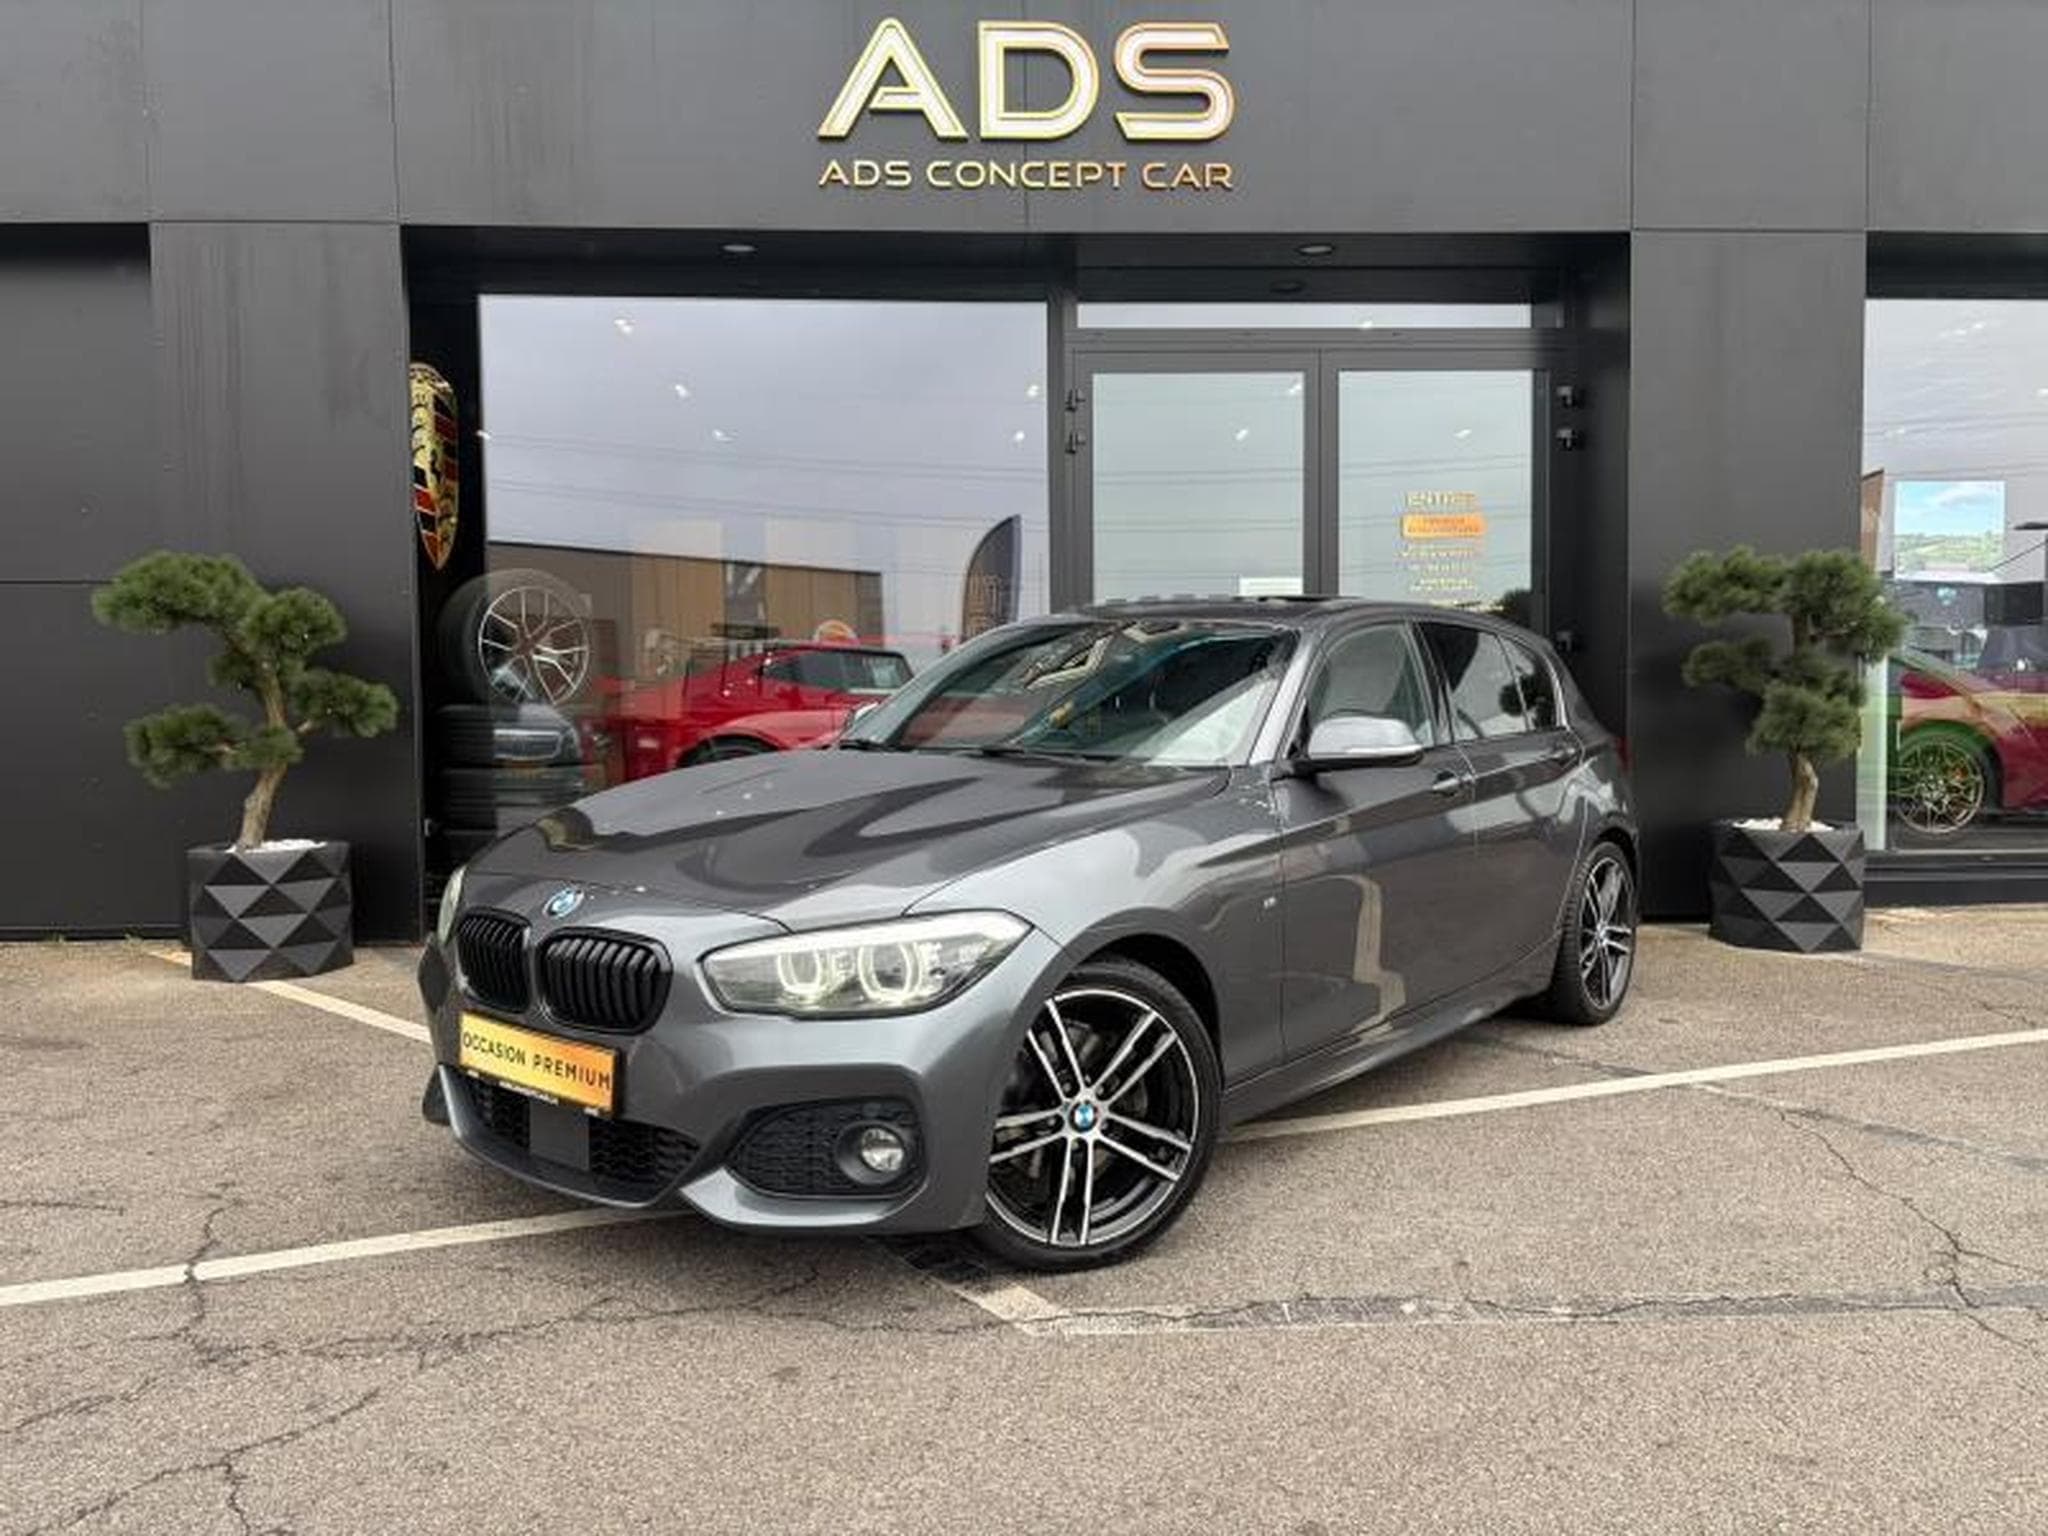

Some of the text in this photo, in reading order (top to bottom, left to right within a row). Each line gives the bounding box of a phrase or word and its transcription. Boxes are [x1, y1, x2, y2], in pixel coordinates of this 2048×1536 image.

[818, 17, 1235, 140] ADS
[818, 160, 1233, 190] ADS CONCEPT CAR
[462, 1032, 610, 1090] OCCASION PREMIUM
